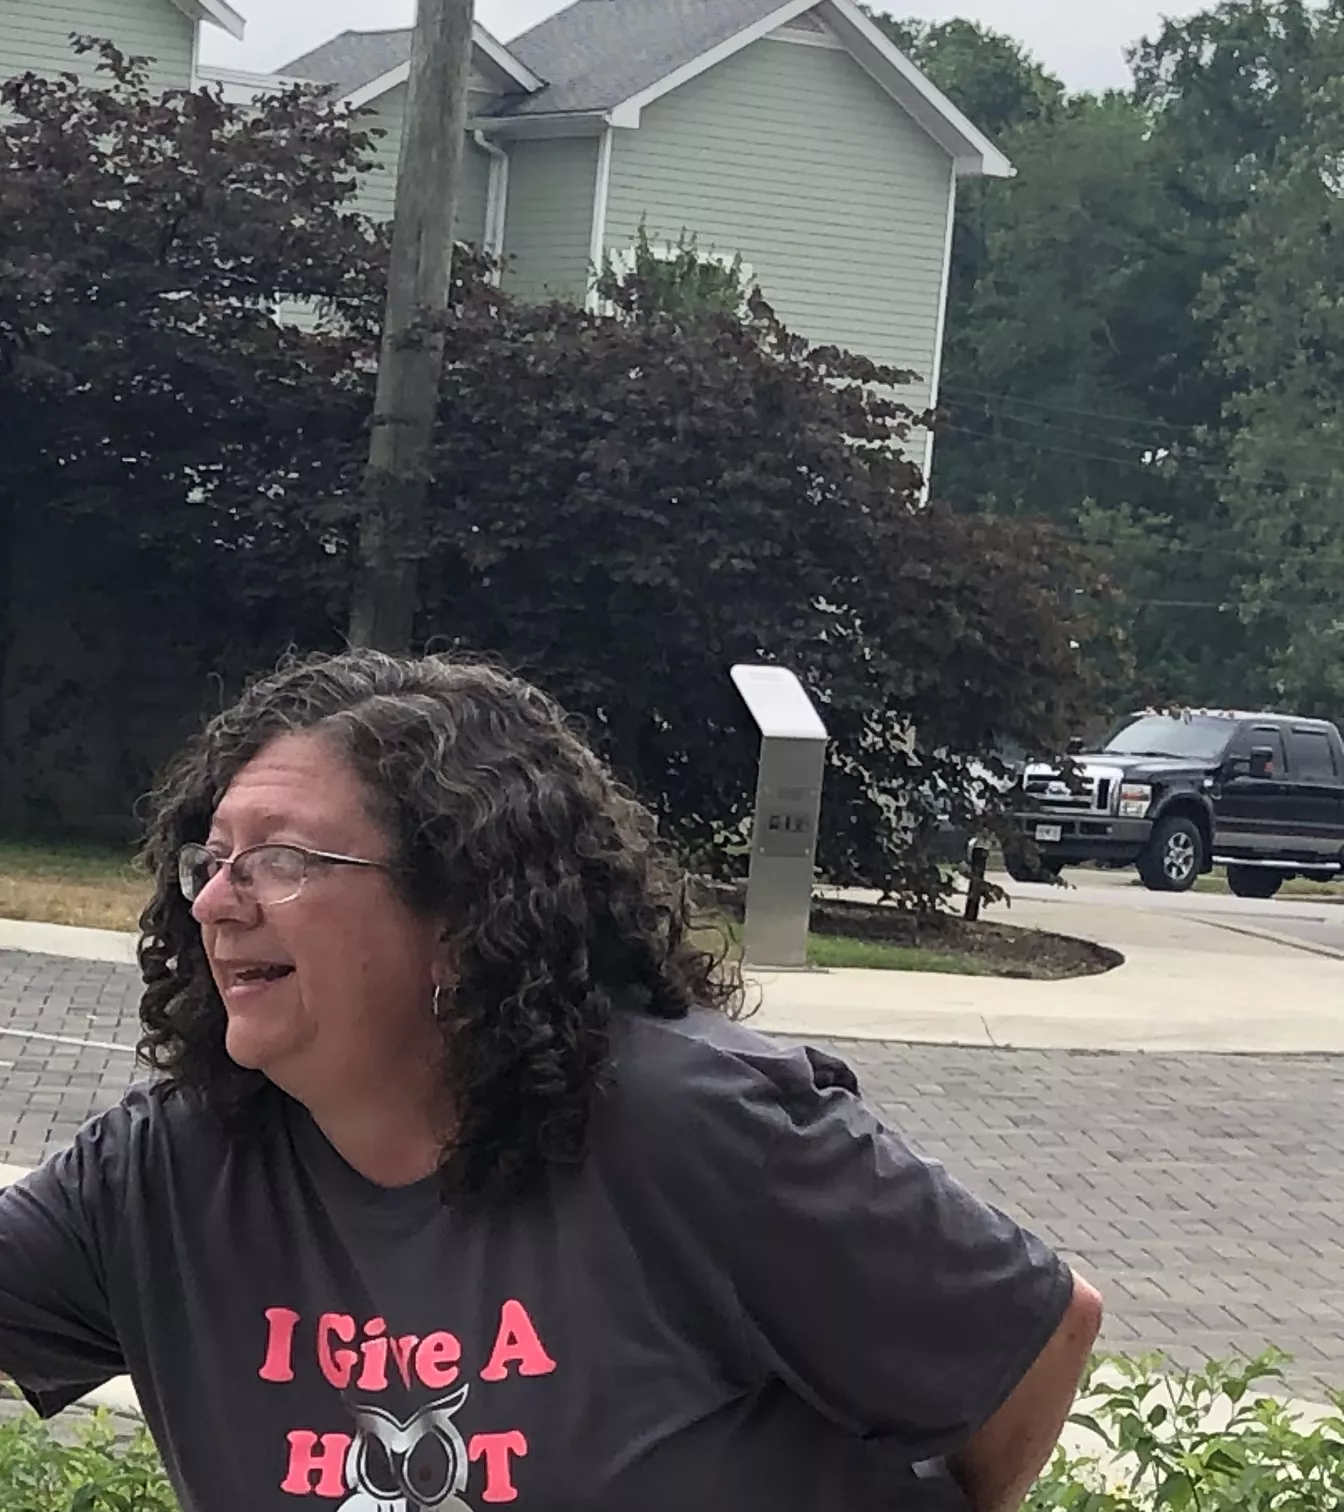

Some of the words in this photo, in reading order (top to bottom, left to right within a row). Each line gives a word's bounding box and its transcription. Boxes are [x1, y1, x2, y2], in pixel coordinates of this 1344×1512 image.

[258, 1307, 301, 1382] I
[317, 1312, 462, 1391] Give
[479, 1299, 557, 1382] A
